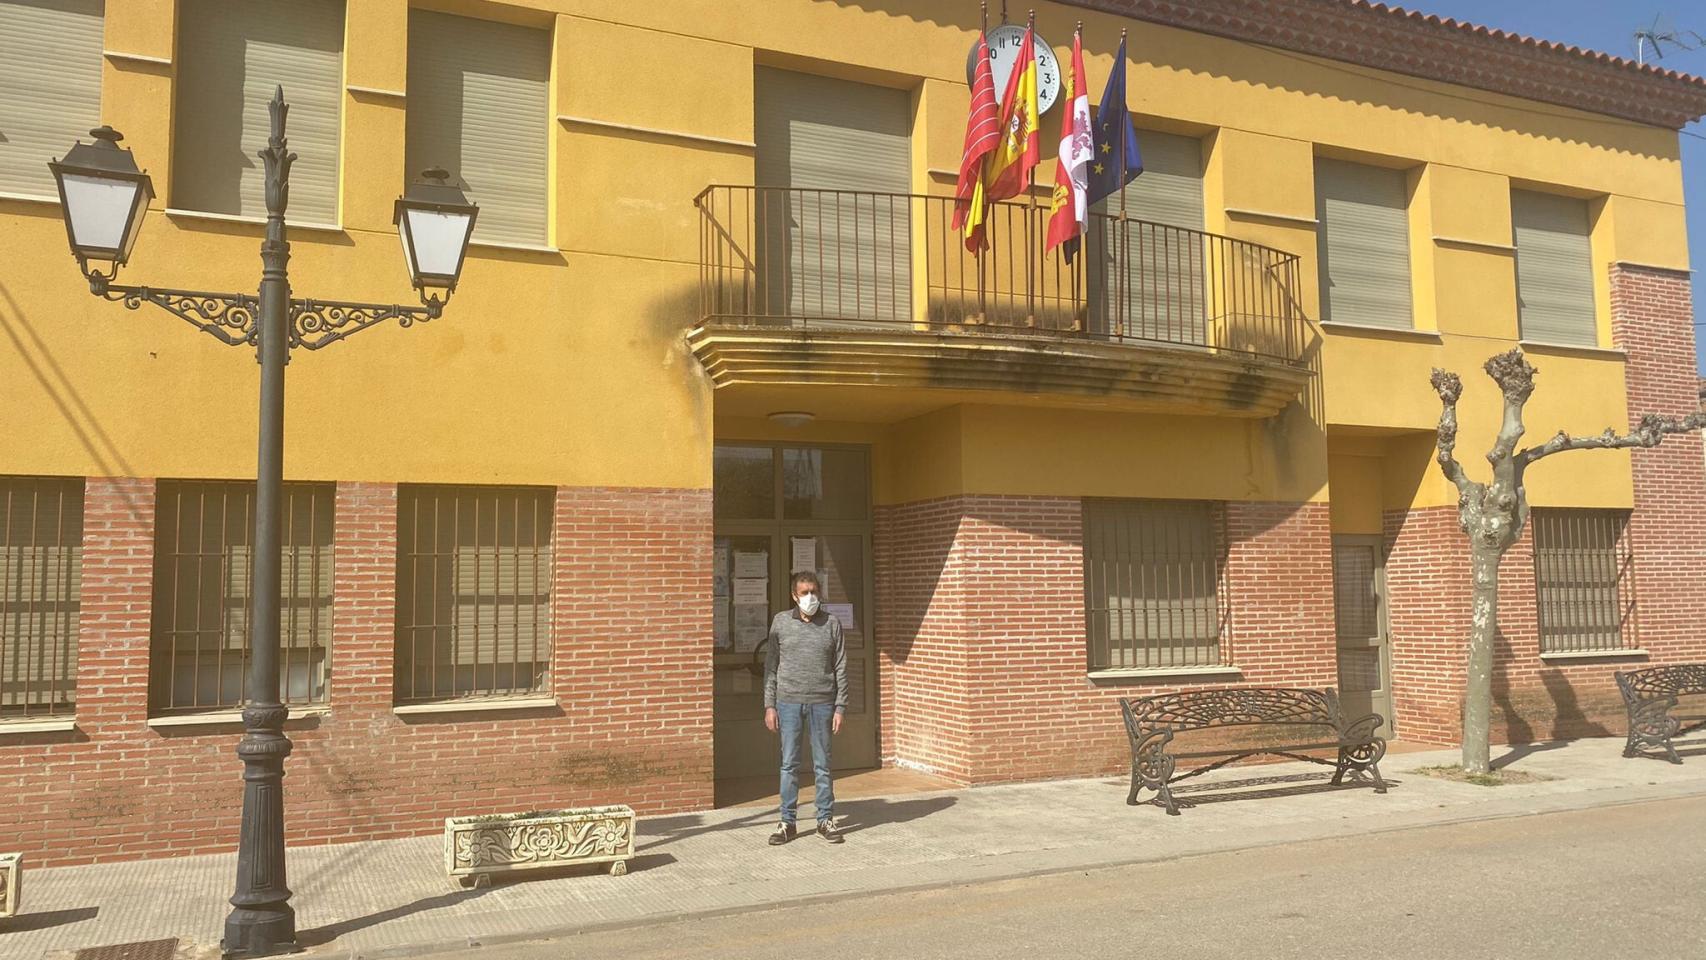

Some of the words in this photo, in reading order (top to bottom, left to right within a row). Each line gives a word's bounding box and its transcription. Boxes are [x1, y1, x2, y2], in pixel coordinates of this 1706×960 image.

[999, 37, 1005, 49] 11
[1012, 34, 1021, 47] 12
[1039, 54, 1046, 66] 2
[1044, 73, 1051, 84] 3
[1040, 89, 1047, 100] 4
